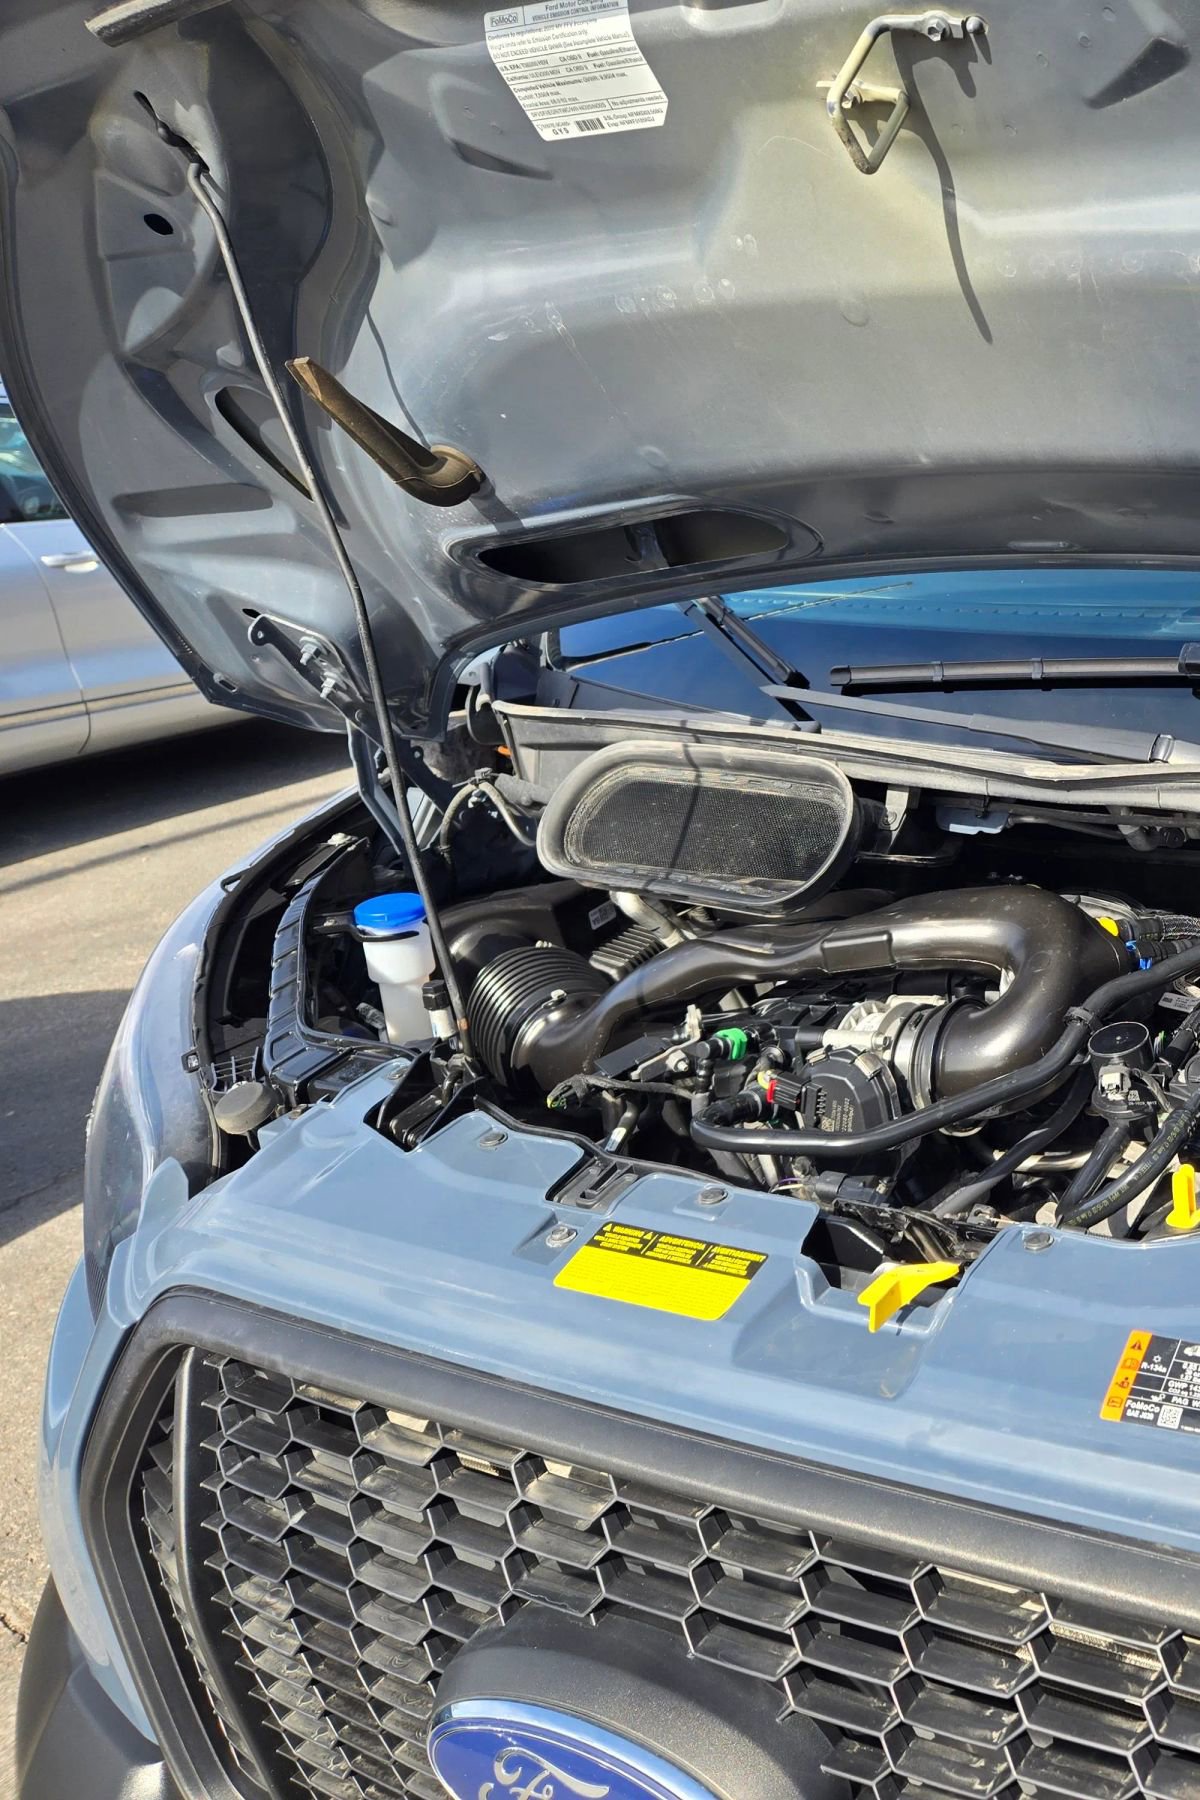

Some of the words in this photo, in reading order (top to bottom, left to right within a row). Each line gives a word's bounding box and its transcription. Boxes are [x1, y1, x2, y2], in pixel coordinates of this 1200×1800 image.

[571, 6, 589, 14] CONTROL
[491, 13, 518, 27] FoMoCo
[1141, 1362, 1167, 1373] R-134a
[1168, 1380, 1188, 1389] GWP
[1126, 1399, 1160, 1413] FoMoCo
